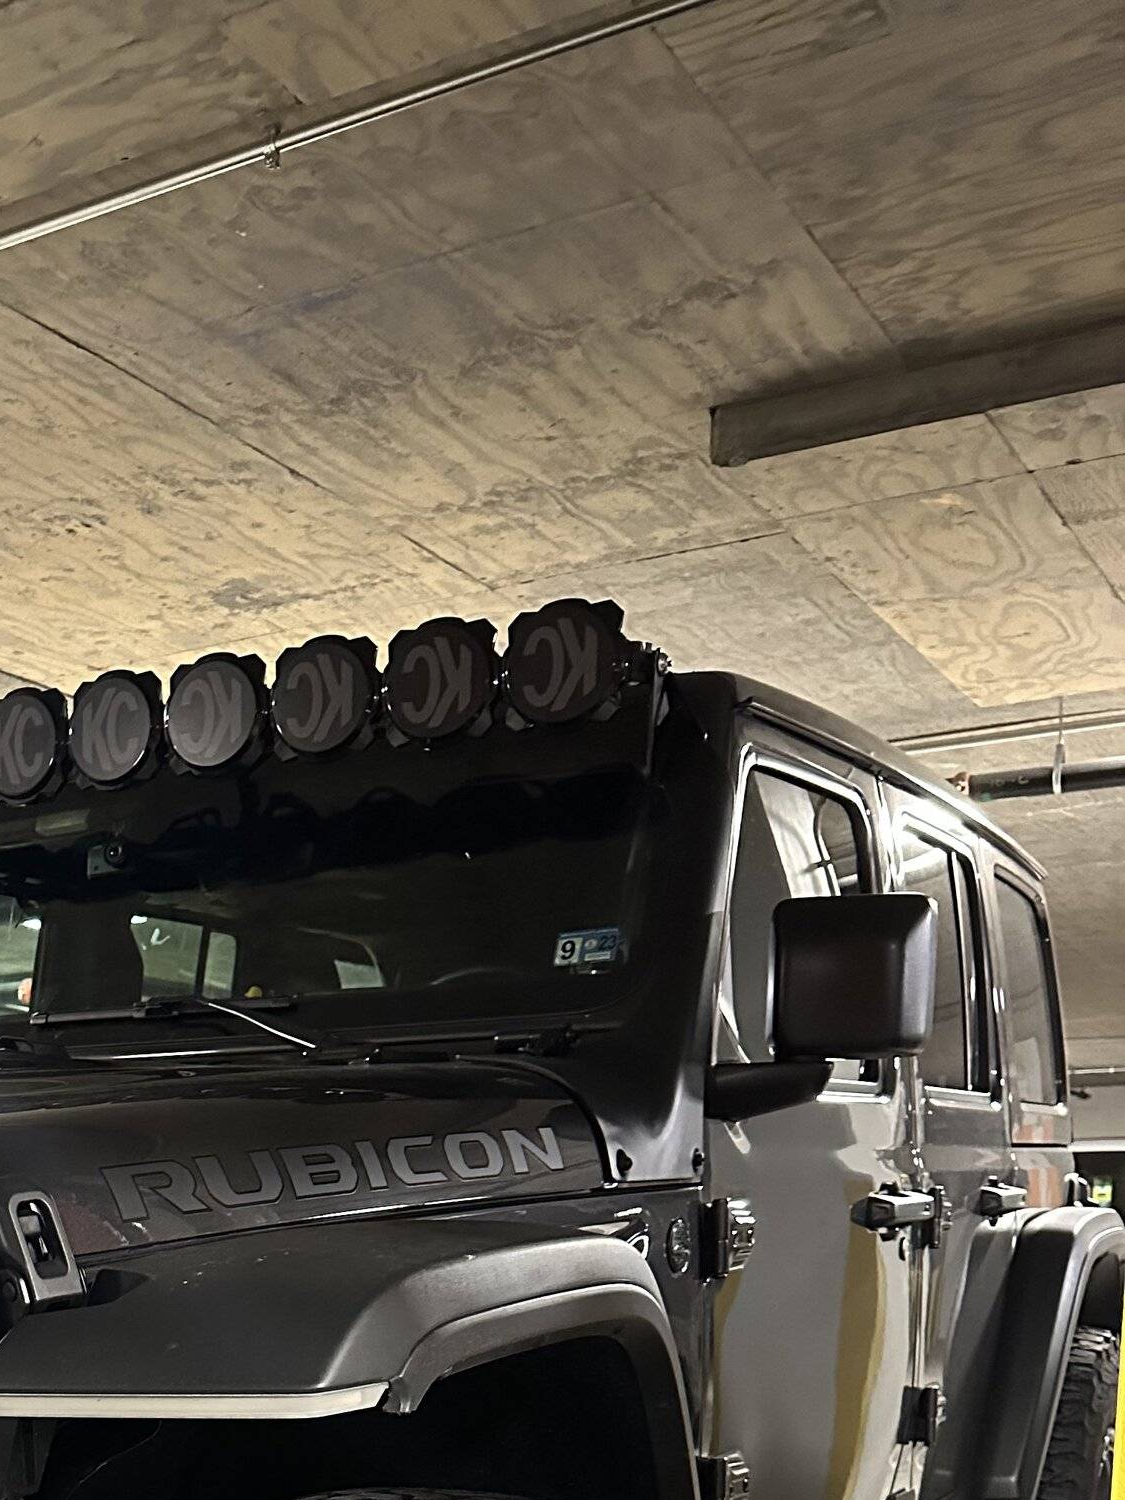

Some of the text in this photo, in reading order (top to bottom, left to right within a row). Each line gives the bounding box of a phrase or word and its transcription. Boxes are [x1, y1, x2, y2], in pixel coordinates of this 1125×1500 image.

[81, 687, 138, 771] KC
[560, 940, 576, 960] 9
[100, 1126, 565, 1223] RUBICON
